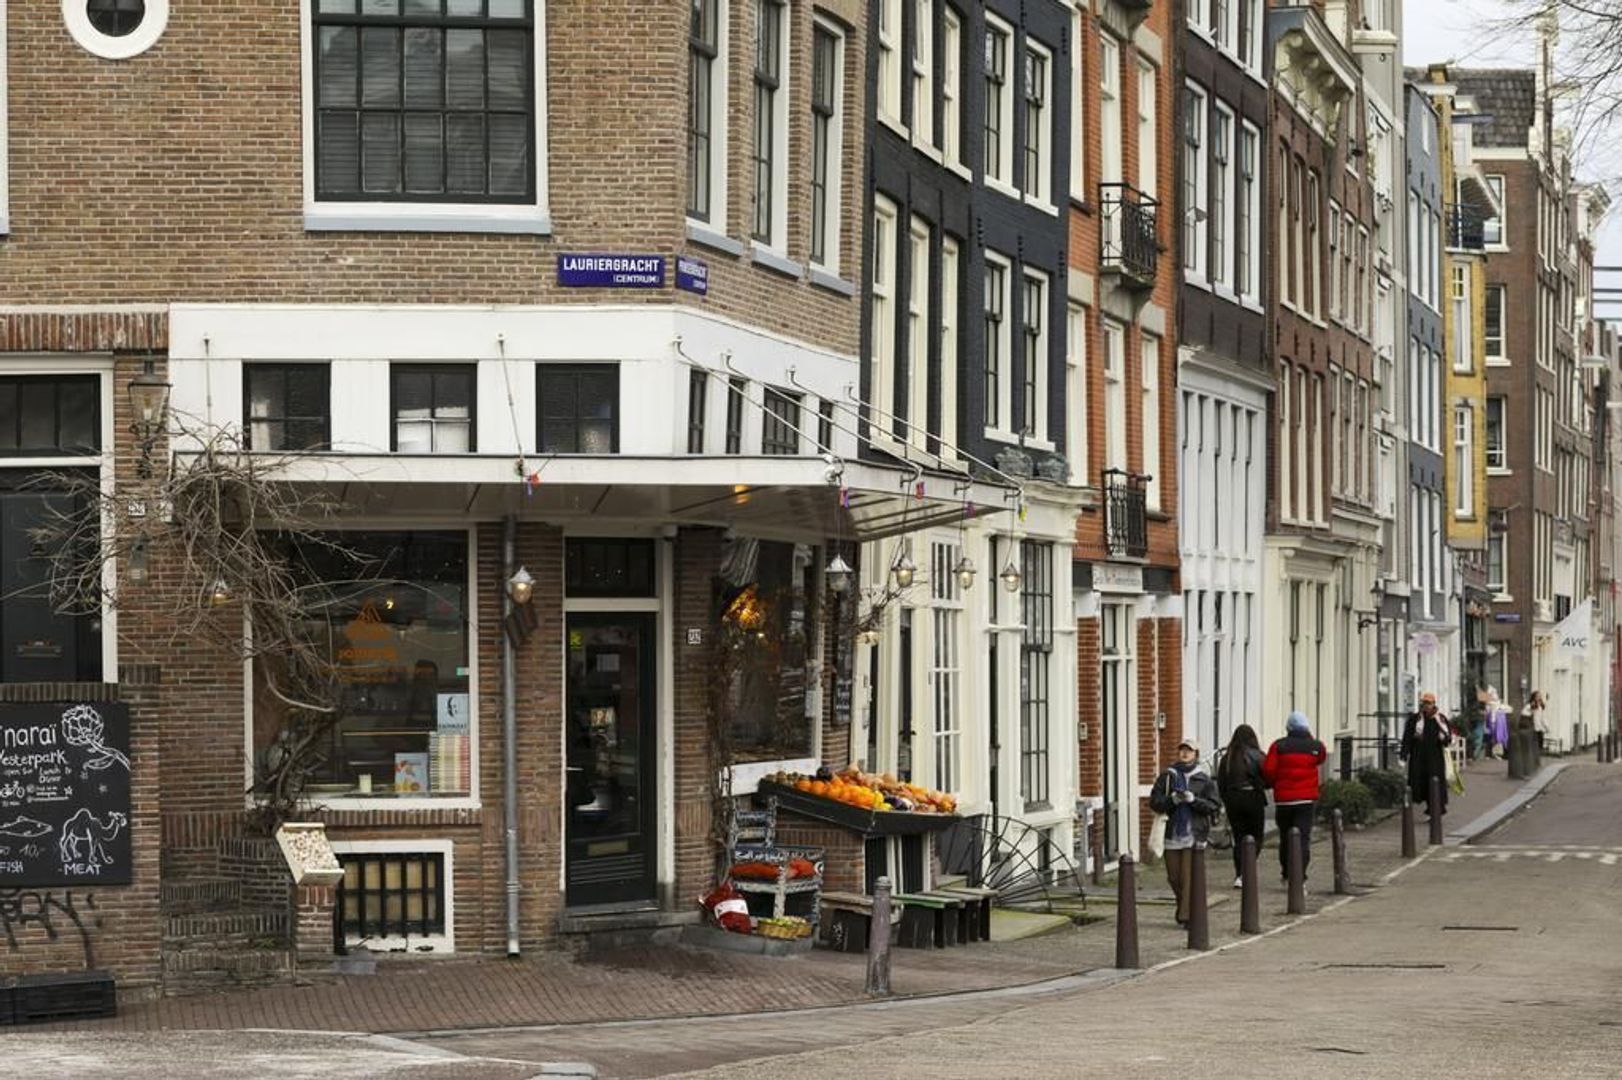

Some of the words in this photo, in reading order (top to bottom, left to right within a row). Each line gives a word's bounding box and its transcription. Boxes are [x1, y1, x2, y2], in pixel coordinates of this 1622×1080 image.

[563, 257, 660, 272] LAURIERGRACHT
[0, 723, 58, 748] naraï
[64, 863, 102, 875] MEAT
